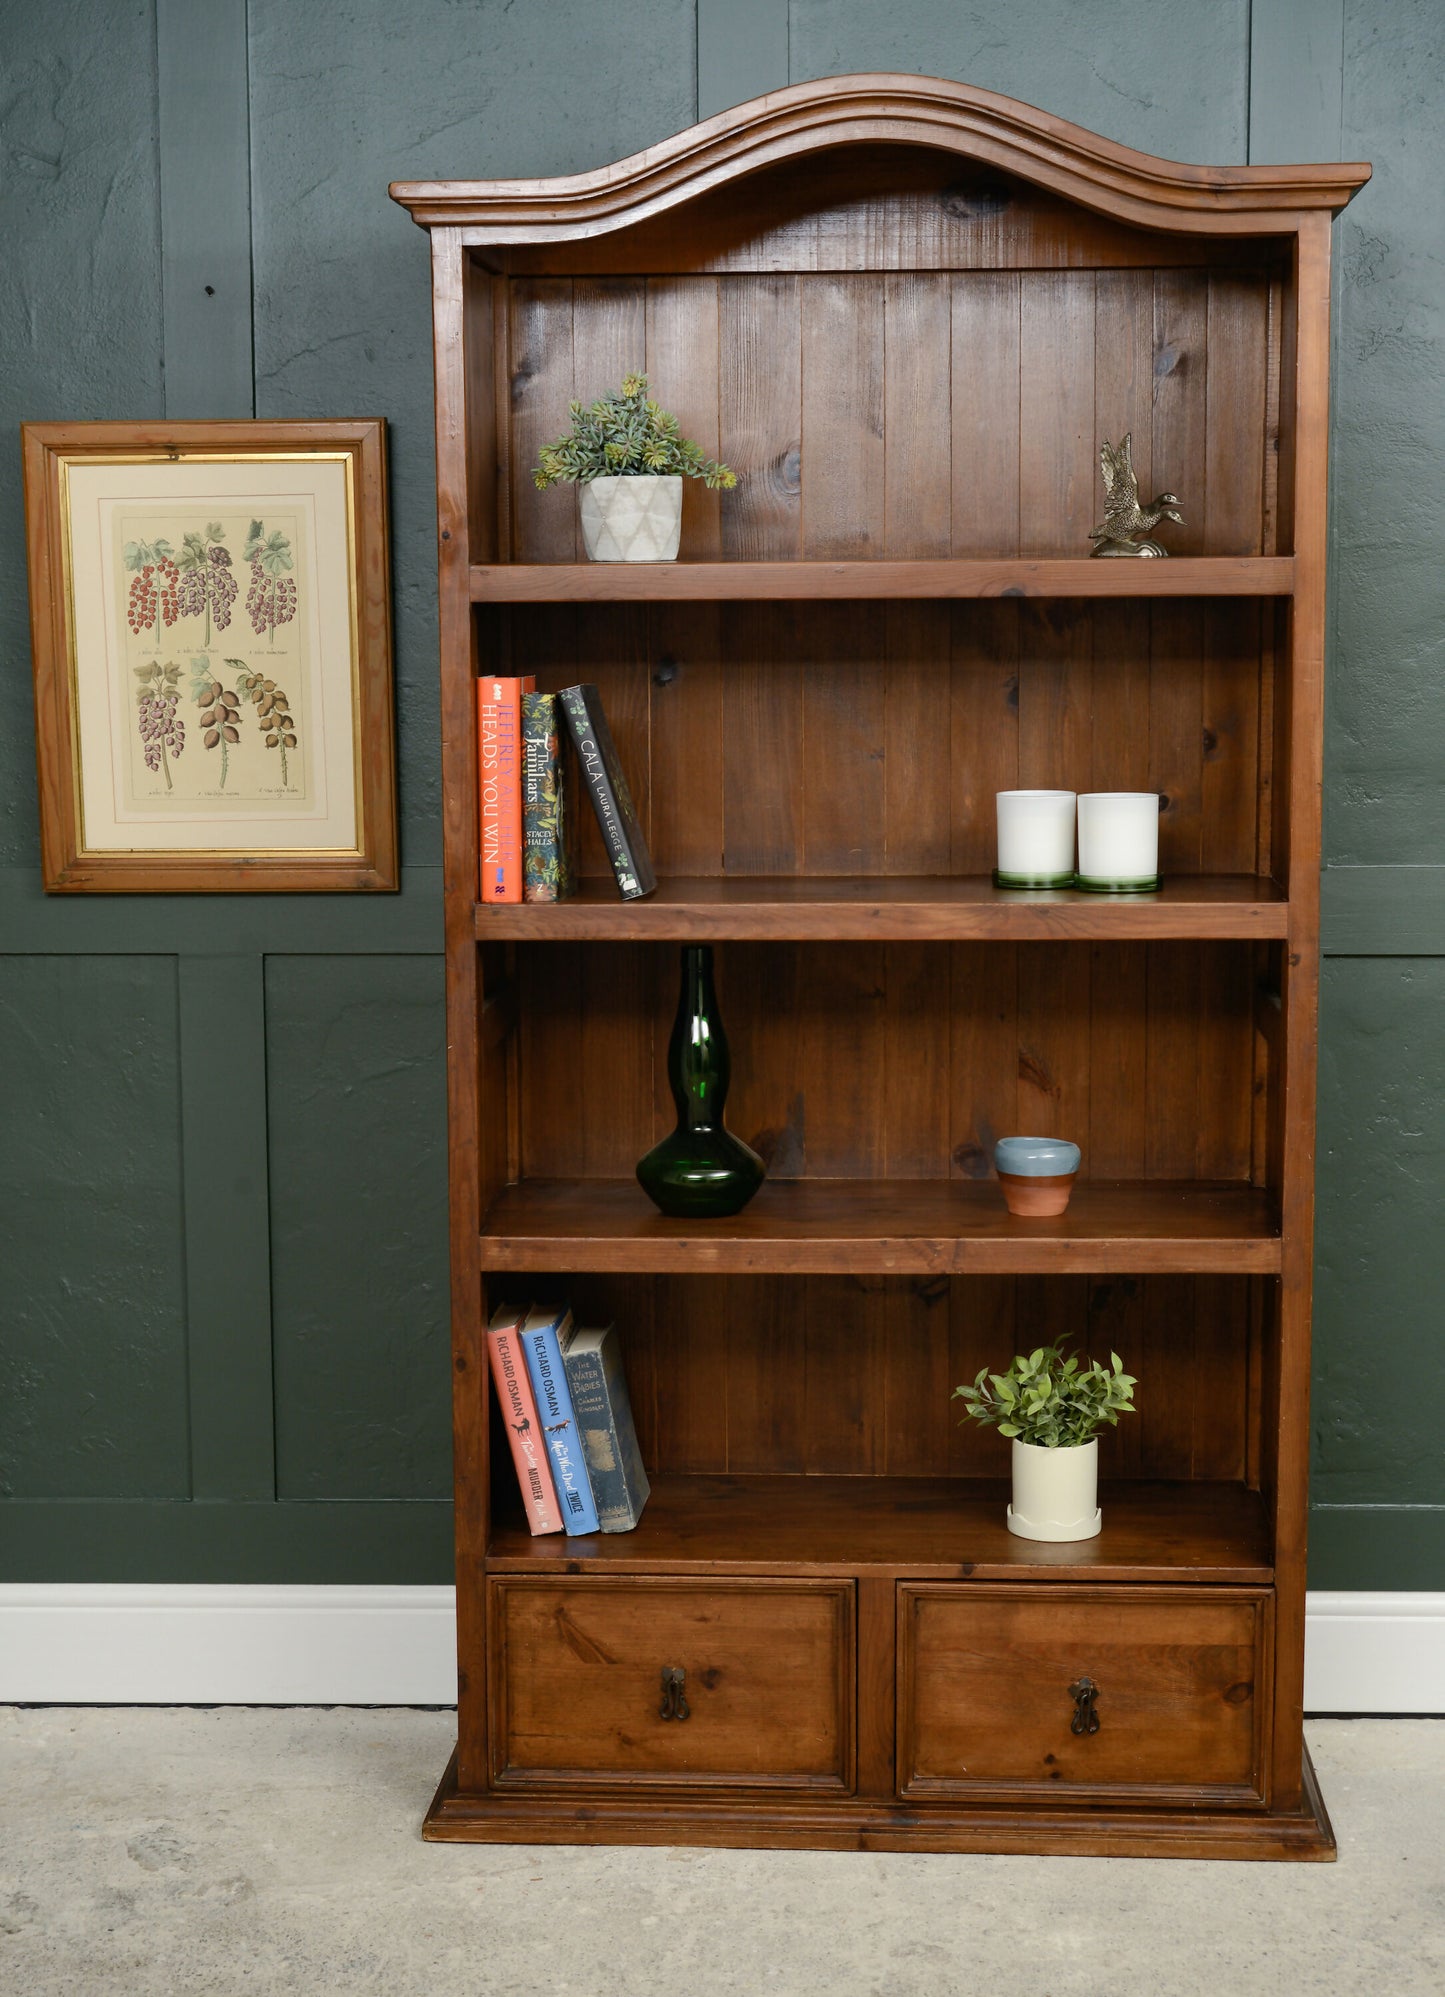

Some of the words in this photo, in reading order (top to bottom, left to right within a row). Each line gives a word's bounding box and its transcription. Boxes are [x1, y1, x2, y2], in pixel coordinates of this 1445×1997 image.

[482, 704, 498, 769] HEADS
[497, 704, 514, 776] JEFFREY
[524, 731, 552, 803] Familiars
[483, 775, 499, 817] YOU
[581, 740, 604, 783] CALA
[596, 786, 611, 818] LAURA
[607, 819, 622, 851] LEGGE
[484, 823, 499, 864] WIN
[526, 830, 553, 838] STACEY
[527, 838, 553, 846] HALLS
[571, 1370, 599, 1381] WATER
[506, 1379, 525, 1417] OSMAN
[543, 1379, 561, 1417] OSMAN
[550, 1440, 565, 1457] Man
[558, 1454, 575, 1474] Who
[527, 1467, 544, 1501] MURDER
[561, 1472, 578, 1492] Died
[567, 1490, 585, 1514] TWICE
